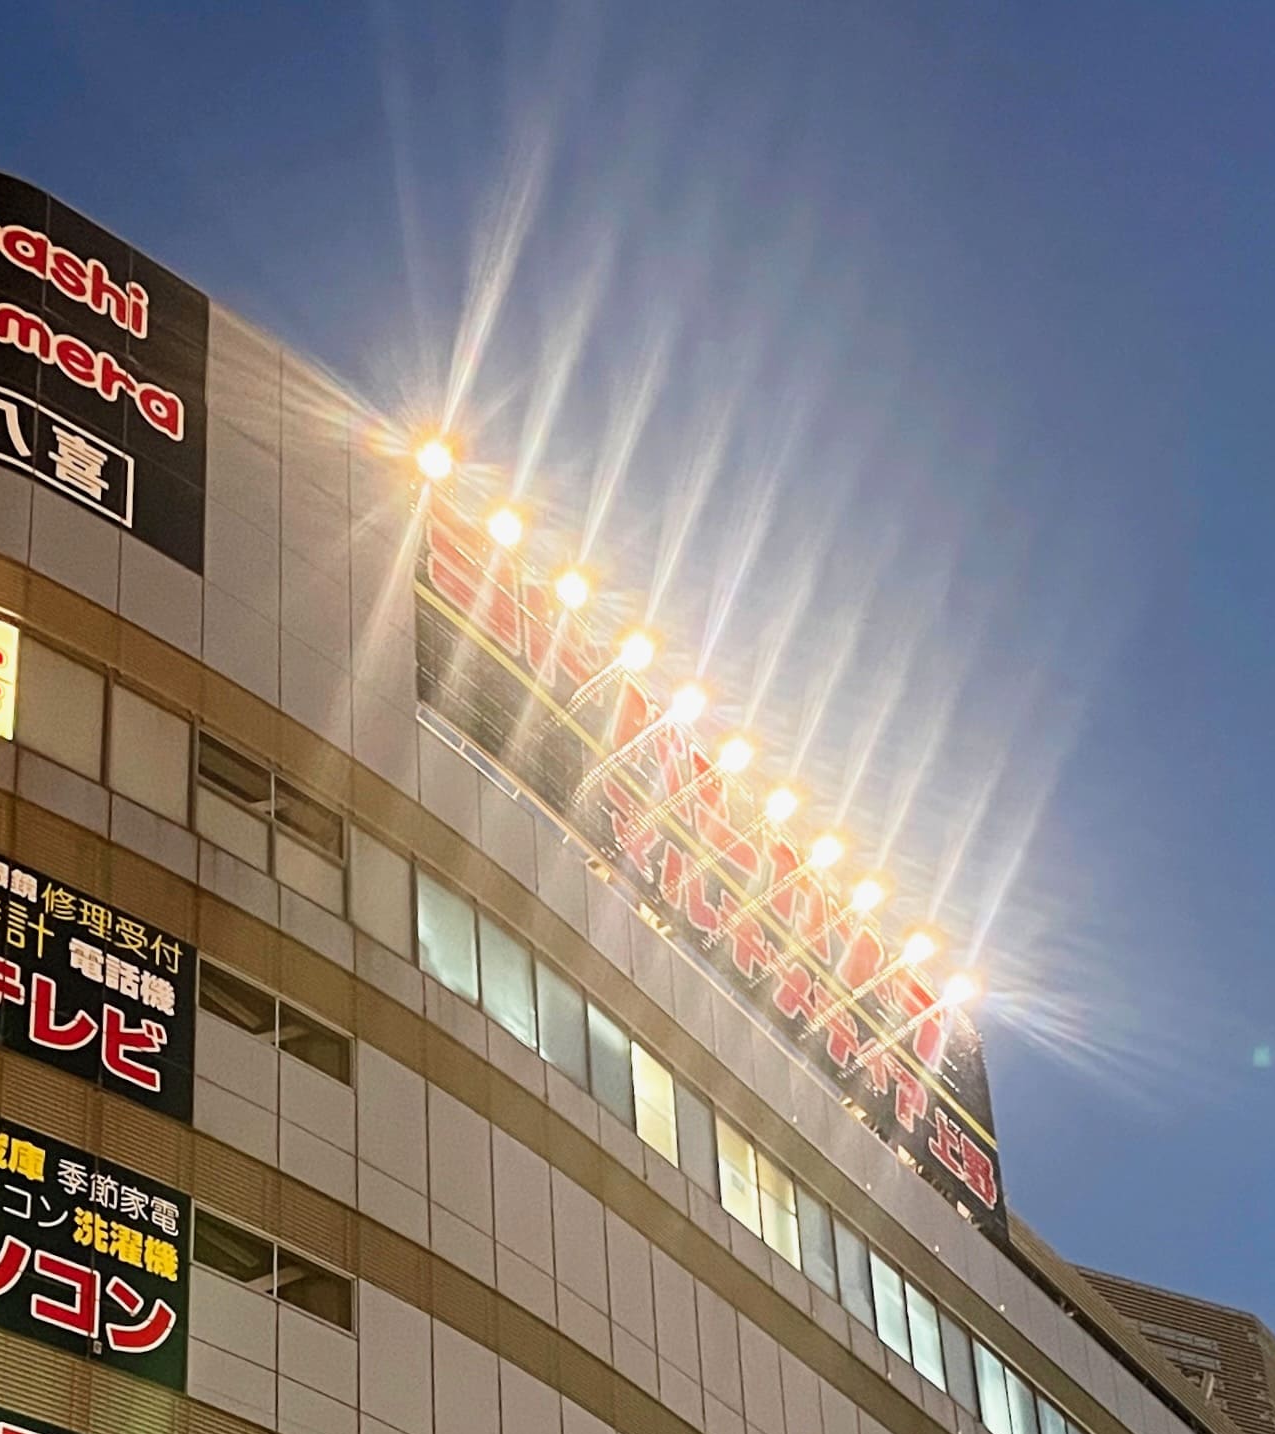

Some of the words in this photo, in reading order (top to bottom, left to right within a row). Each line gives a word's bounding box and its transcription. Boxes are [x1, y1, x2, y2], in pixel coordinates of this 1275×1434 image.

[40, 881, 184, 975] 修理受付
[69, 936, 176, 1017] 電話機
[56, 1157, 180, 1237] 季節家電
[72, 1205, 179, 1282] 洗濯機
